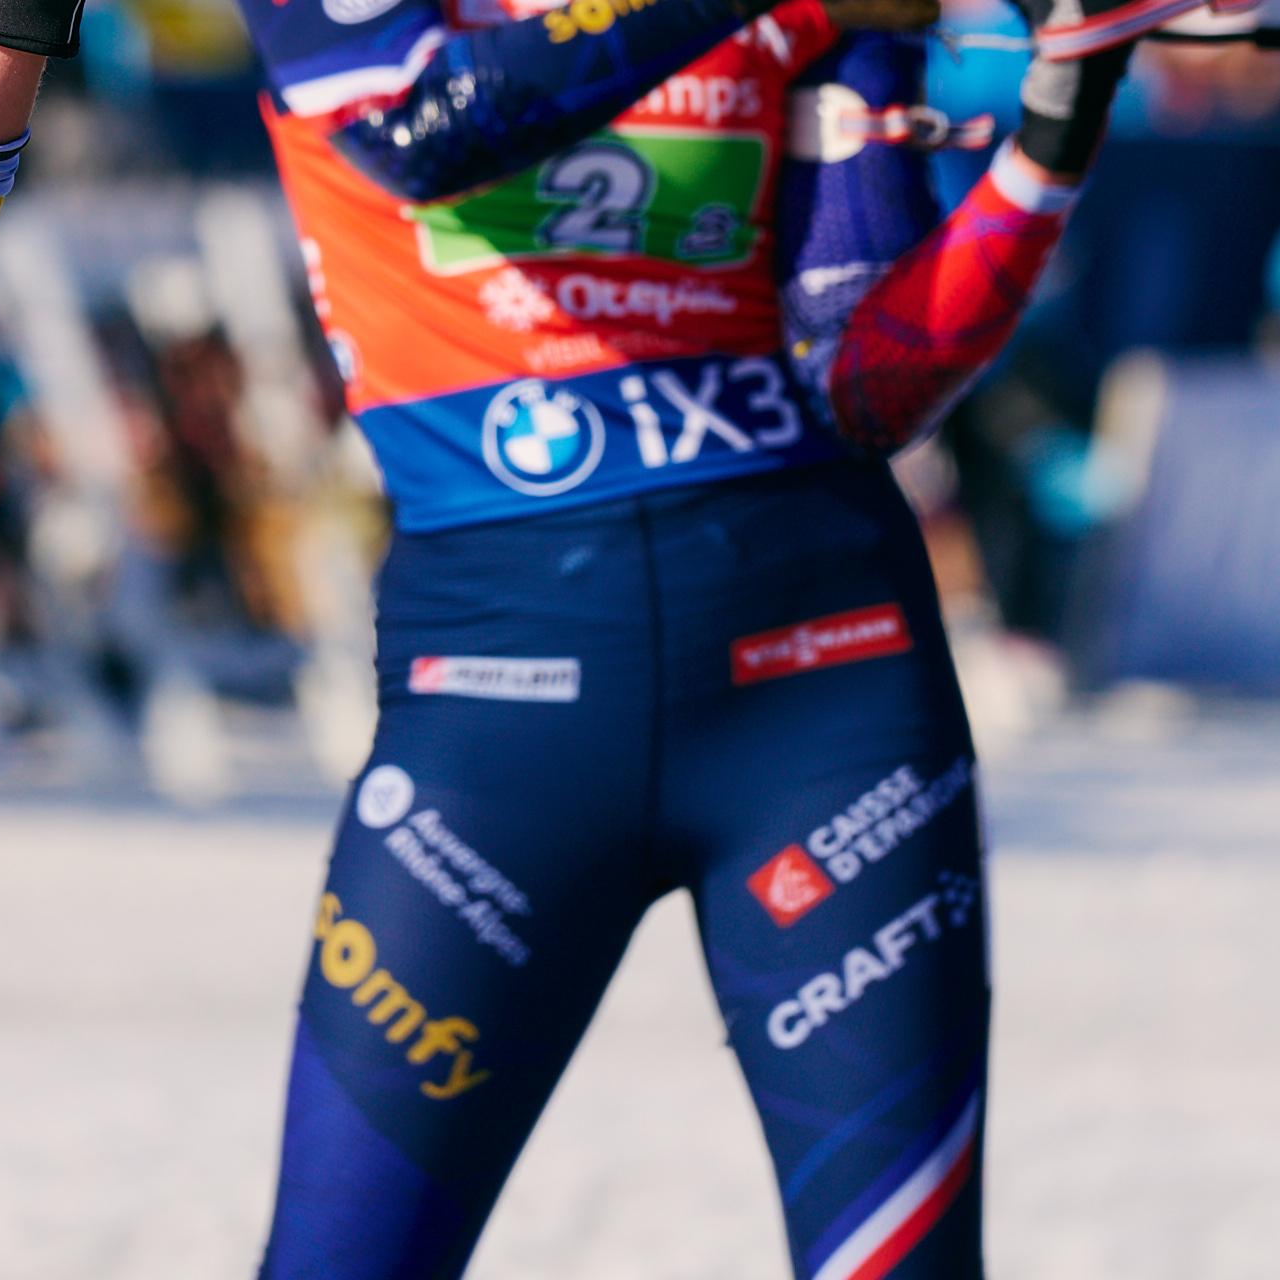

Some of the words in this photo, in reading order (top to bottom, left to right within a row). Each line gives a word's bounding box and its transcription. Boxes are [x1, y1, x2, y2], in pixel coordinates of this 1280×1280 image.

[635, 70, 761, 123] mps
[536, 142, 656, 252] 2
[620, 358, 802, 468] iX3
[808, 763, 923, 860] CAISSE
[314, 891, 492, 1099] somfy
[767, 892, 942, 1050] CRAFT
